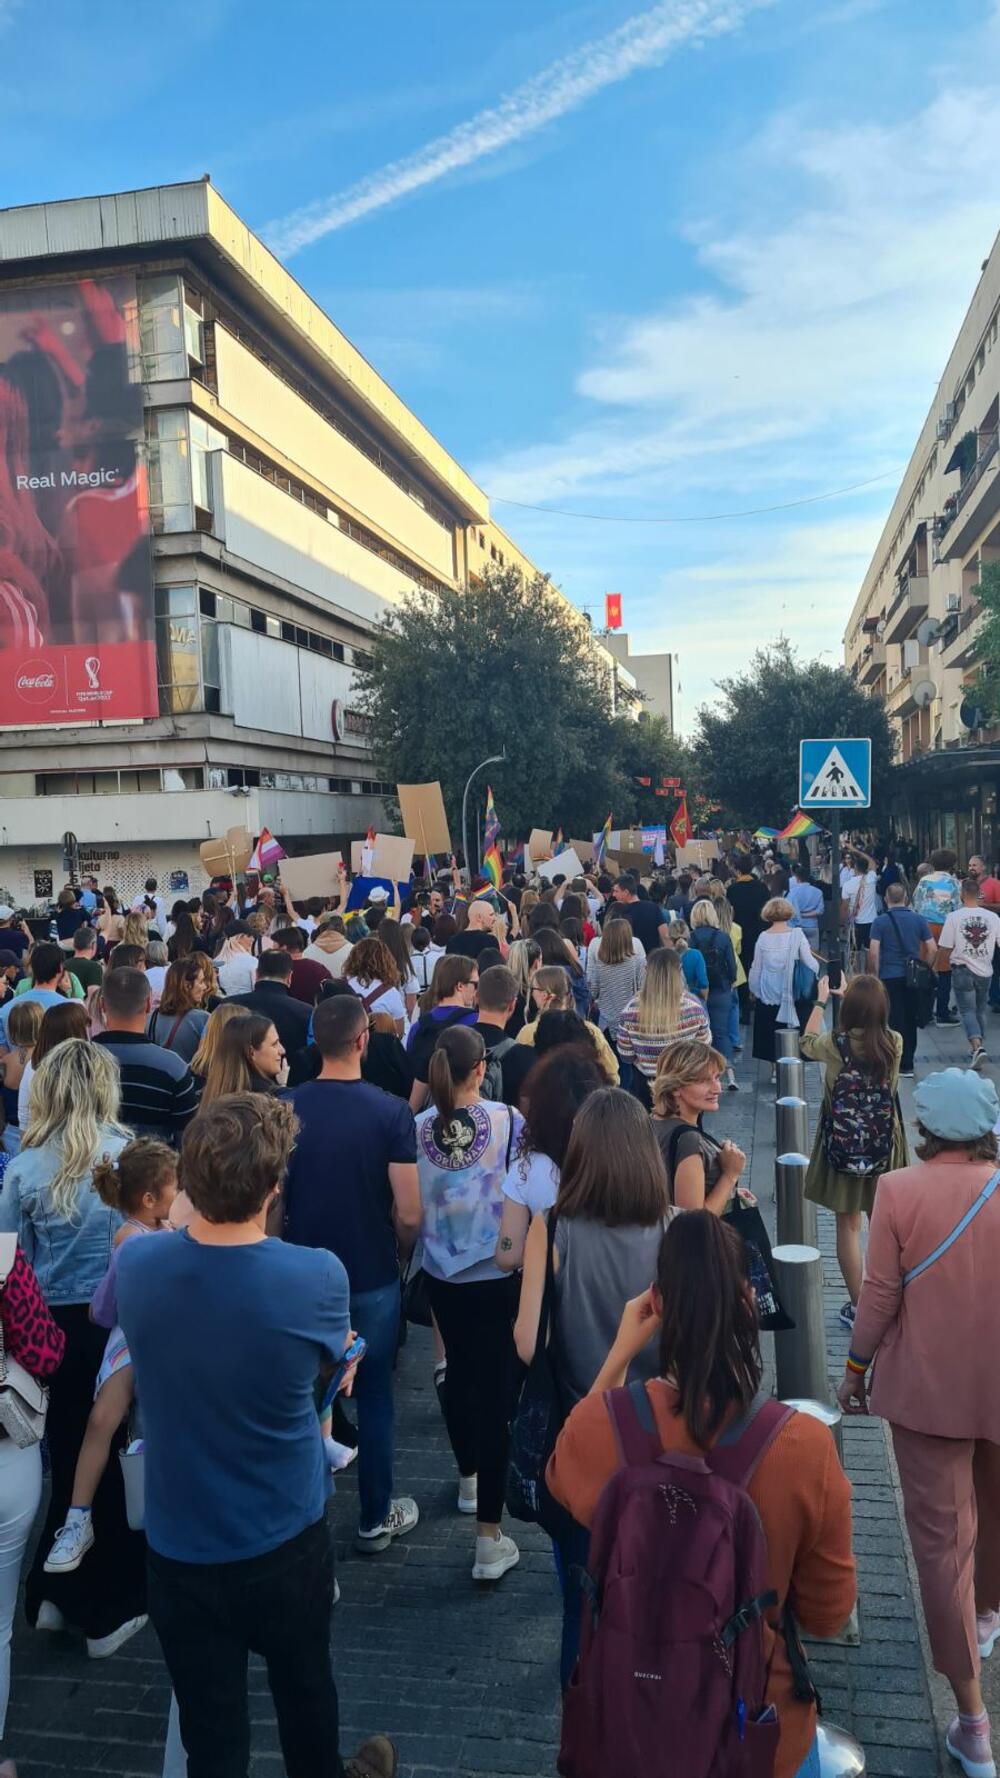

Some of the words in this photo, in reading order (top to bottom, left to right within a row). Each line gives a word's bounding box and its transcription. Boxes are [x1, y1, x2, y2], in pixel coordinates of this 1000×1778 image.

[16, 472, 56, 490] Real
[60, 467, 116, 487] Magic
[17, 674, 54, 689] Coca-Cola
[78, 848, 120, 861] kulturno
[78, 861, 101, 875] ljeto
[466, 1104, 488, 1132] OUSE
[433, 1144, 484, 1168] ORIGINAL
